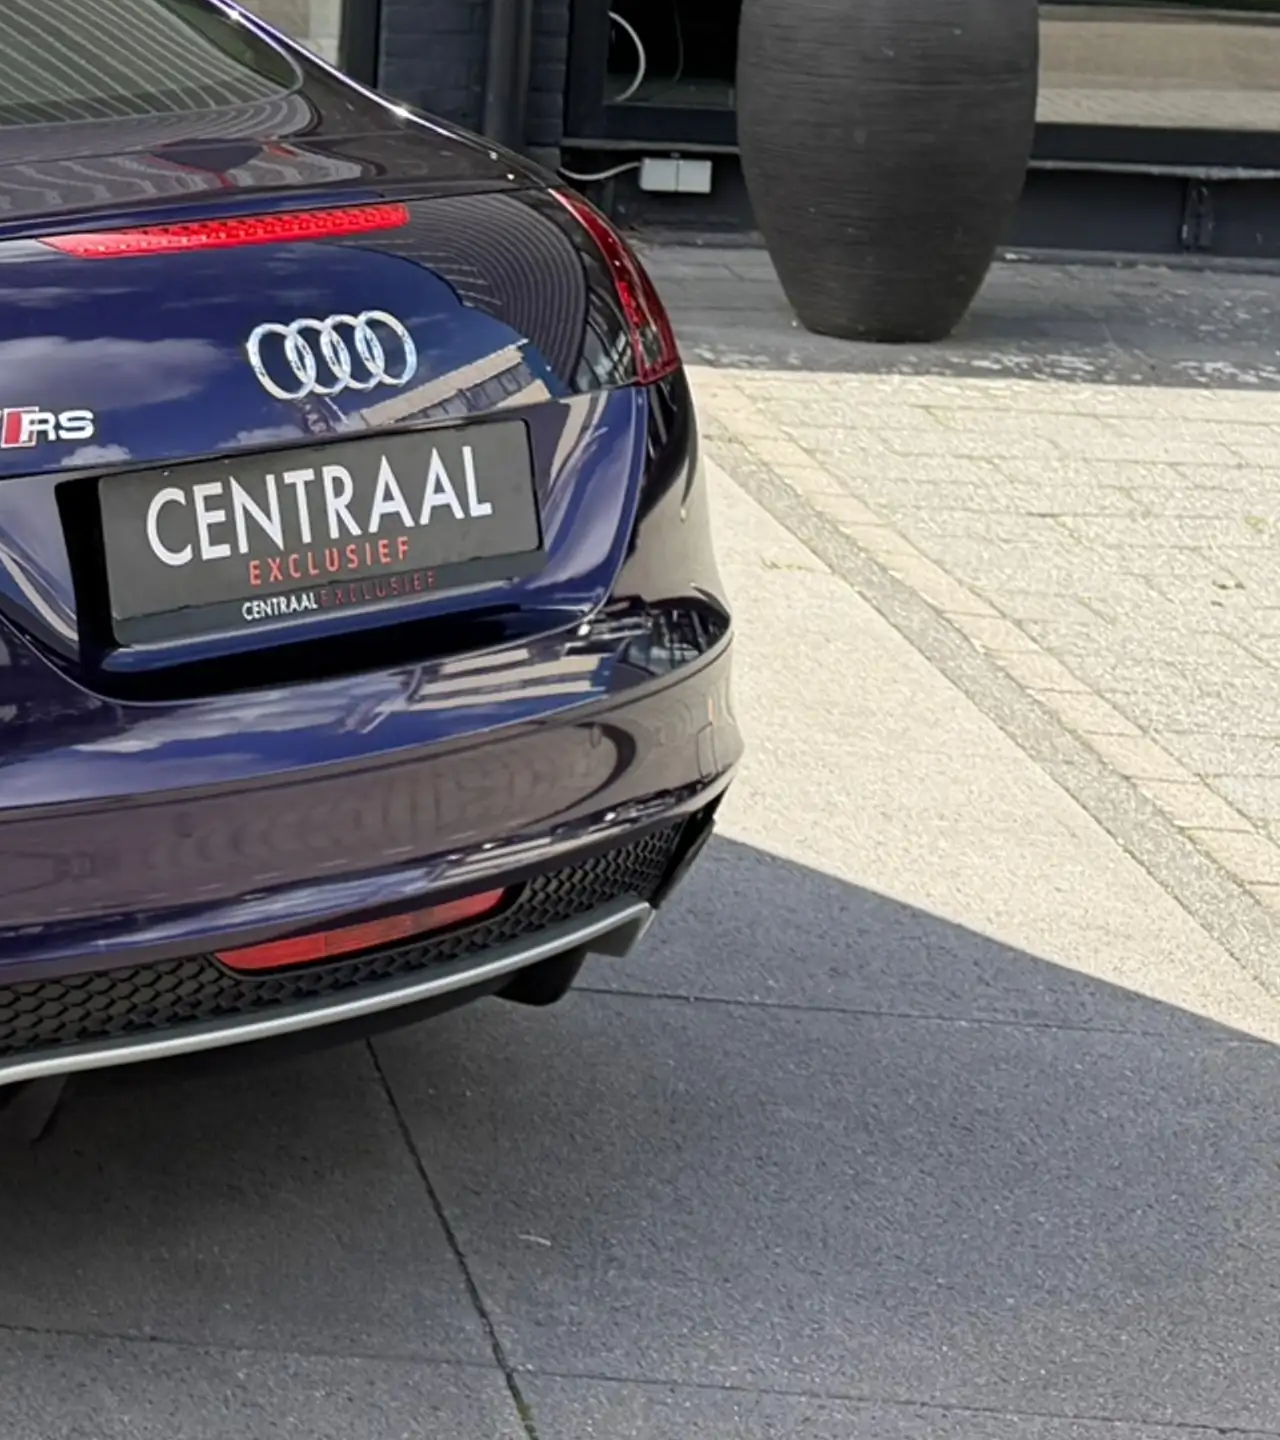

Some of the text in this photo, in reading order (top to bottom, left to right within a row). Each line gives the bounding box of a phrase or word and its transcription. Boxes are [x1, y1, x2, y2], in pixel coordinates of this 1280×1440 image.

[146, 444, 494, 567] CENTRAAL
[249, 536, 411, 586] EXCLUSIEF
[242, 570, 436, 621] CENTRAAL EXCLUSIEF
